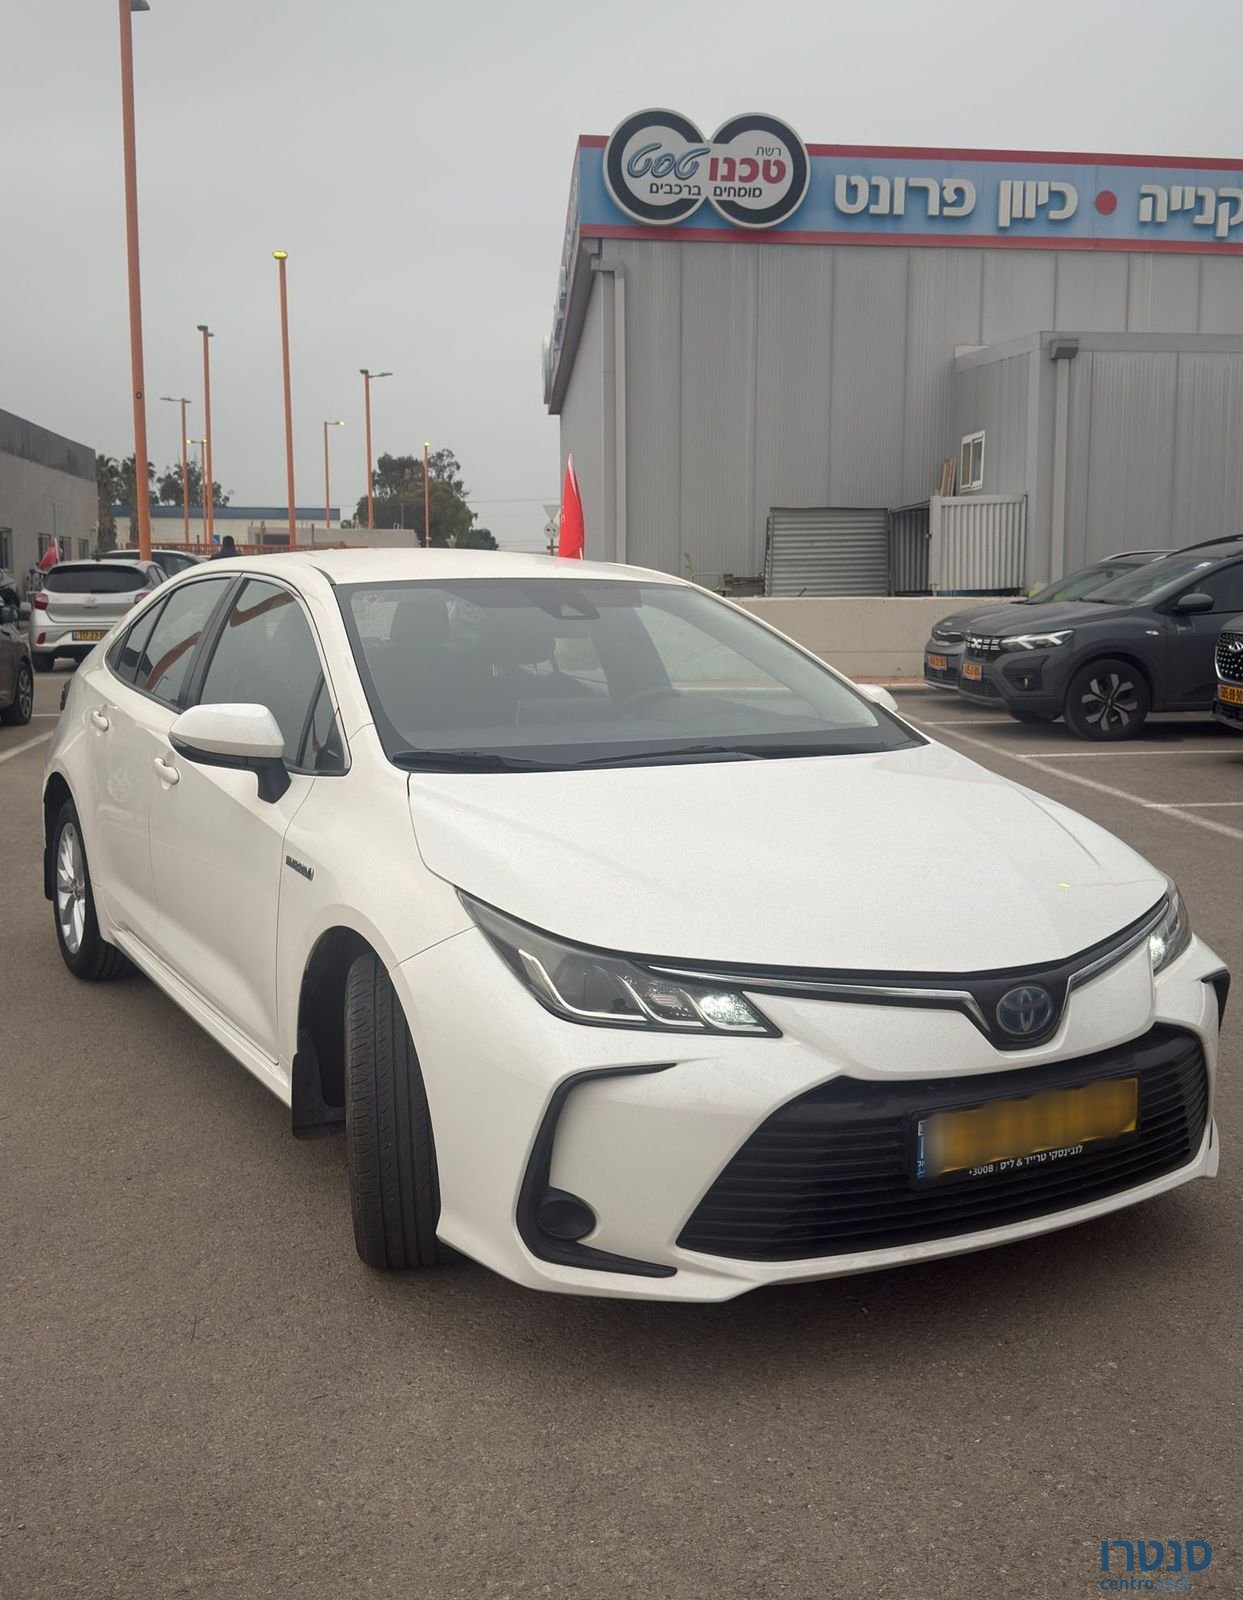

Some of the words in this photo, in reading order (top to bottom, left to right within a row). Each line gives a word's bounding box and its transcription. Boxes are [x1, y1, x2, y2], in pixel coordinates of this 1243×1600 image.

[756, 146, 782, 157] רשת
[626, 142, 711, 180] טסט
[708, 157, 787, 184] טכנו
[649, 182, 702, 196] ברכבים
[713, 185, 763, 198] מומחים
[834, 174, 977, 217] פרונט
[997, 179, 1079, 229] כיוון
[1138, 184, 1243, 239] קנייה
[1024, 1153, 1047, 1165] טרייד
[1048, 1144, 1084, 1161] לובינסקי
[1016, 1158, 1023, 1167] &
